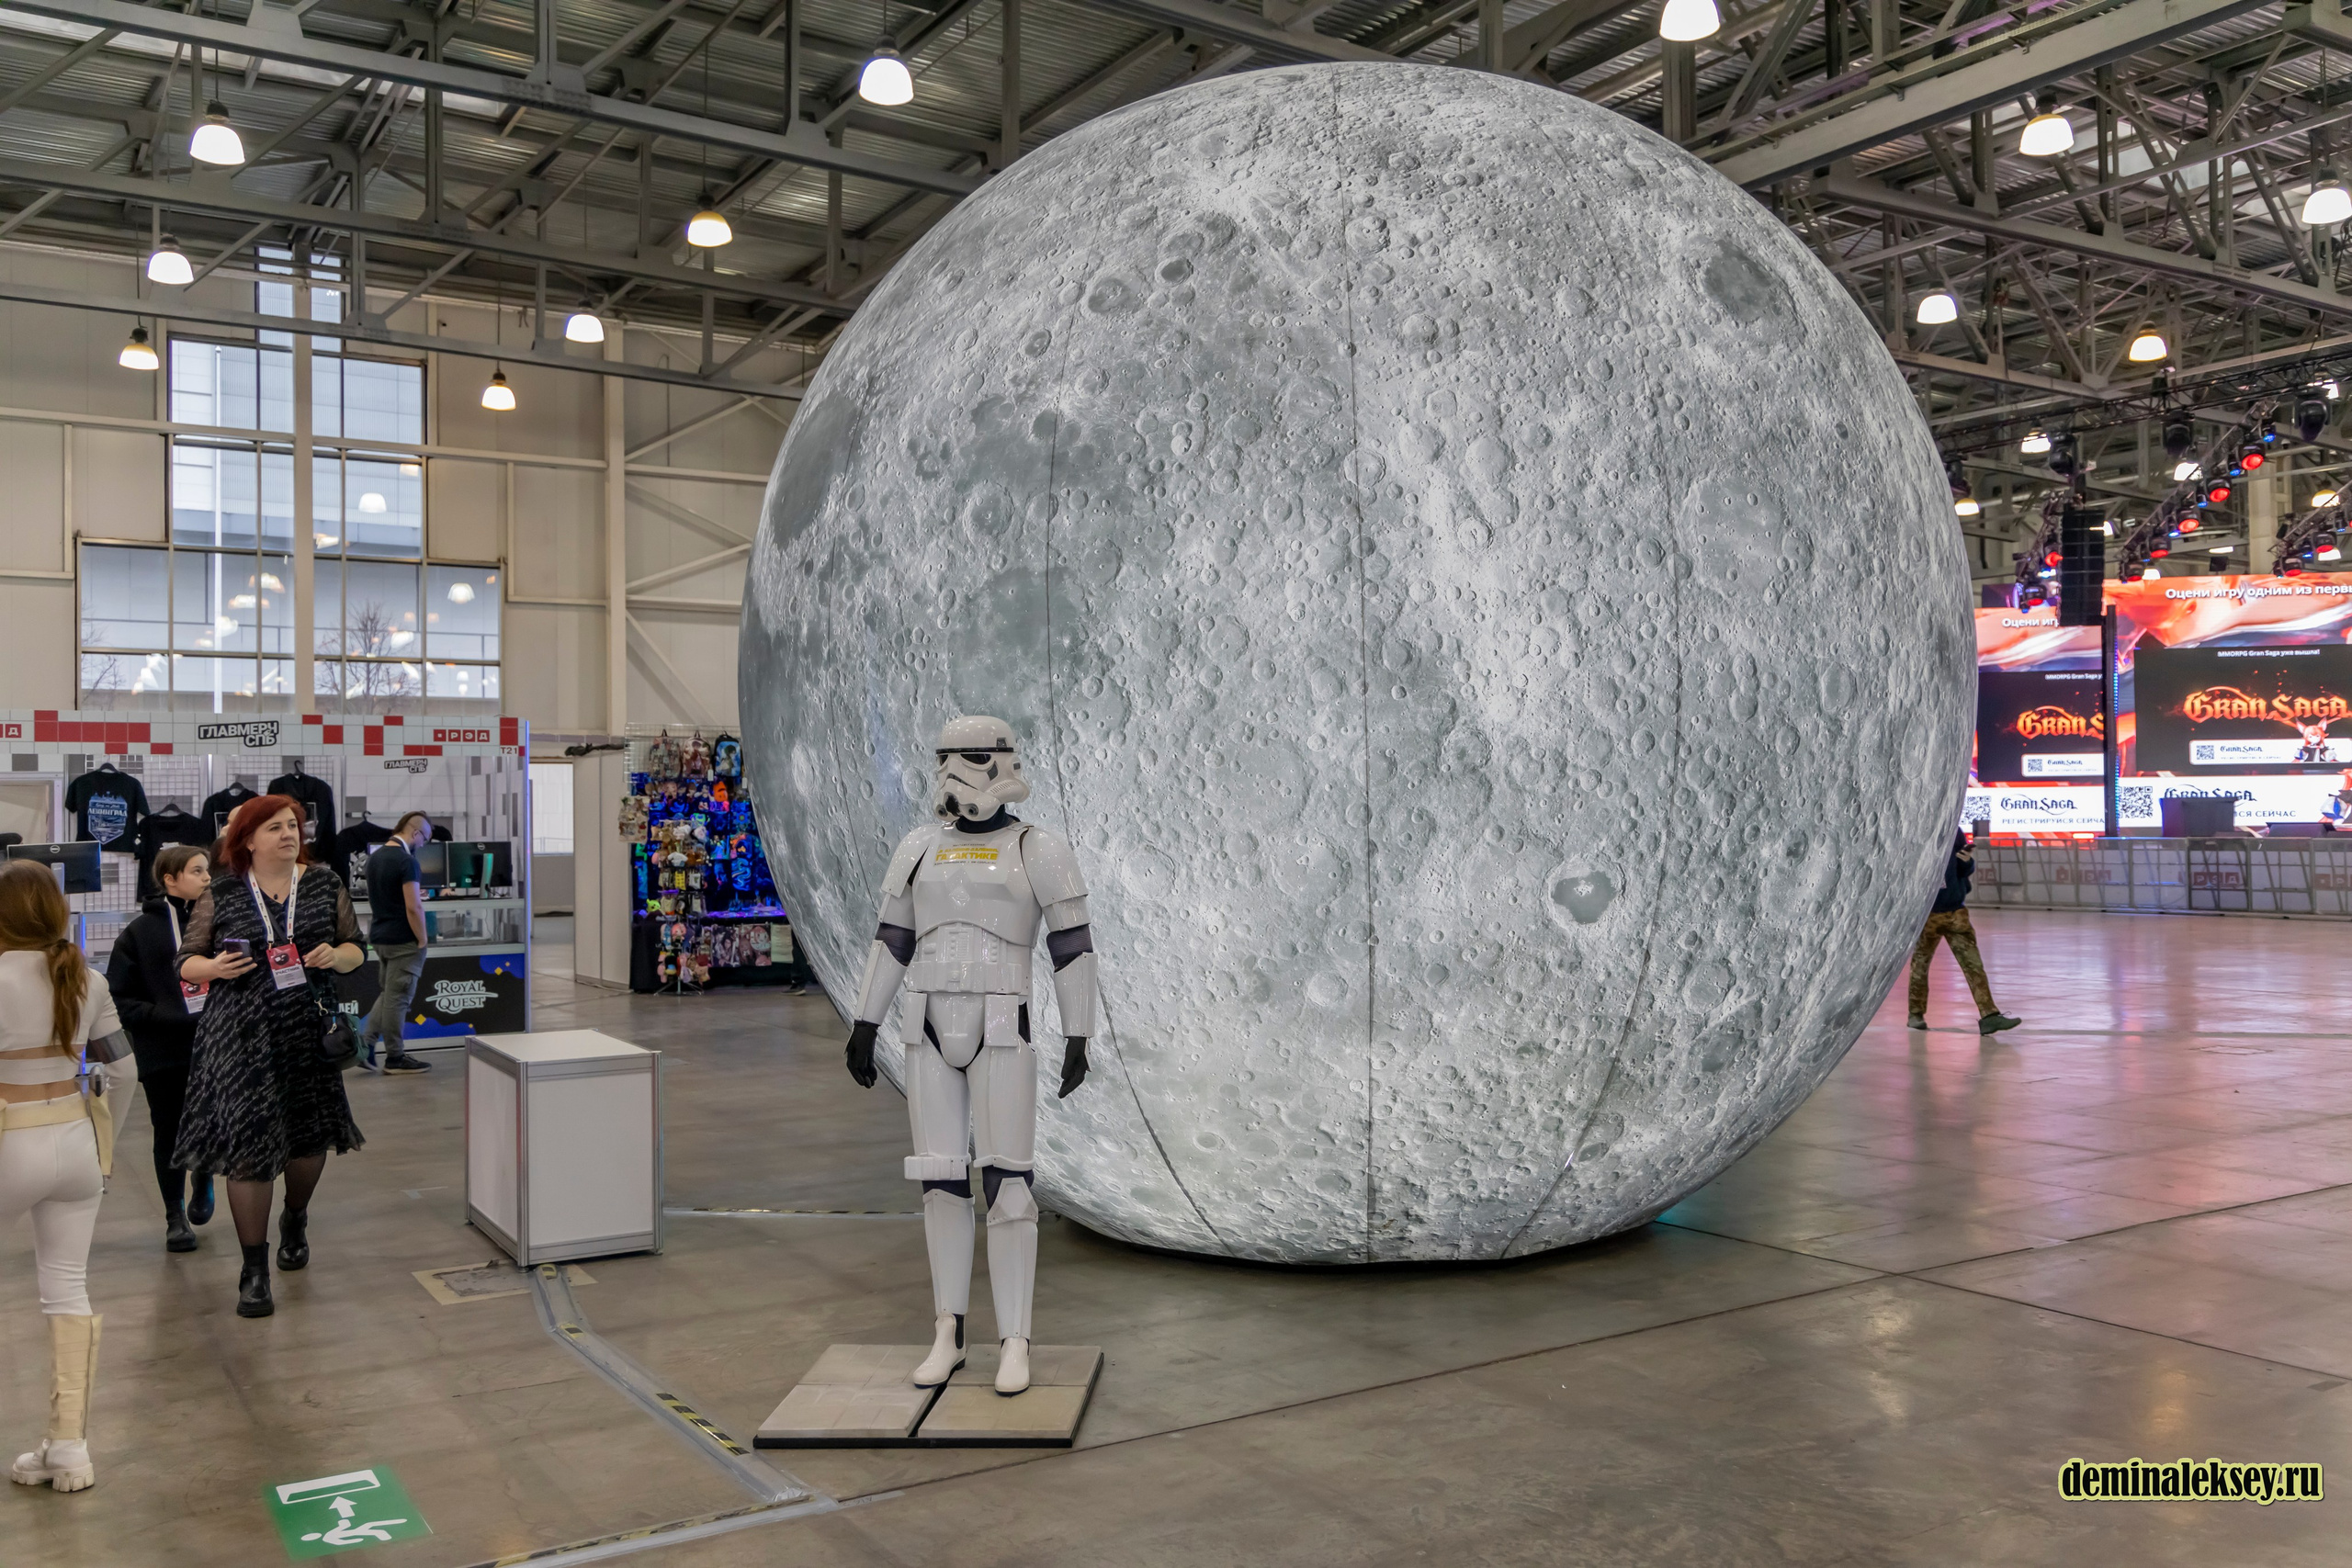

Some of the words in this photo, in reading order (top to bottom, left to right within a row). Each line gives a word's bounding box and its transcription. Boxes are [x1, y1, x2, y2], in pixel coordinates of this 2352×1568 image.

[2165, 588, 2211, 599] Оцени
[2213, 588, 2244, 599] игру
[2246, 585, 2292, 597] одним
[2296, 586, 2312, 595] из
[2002, 618, 2040, 628] Оцени
[198, 721, 278, 739] ГЛАВМЕРЧ
[244, 734, 276, 747] СПБ
[2255, 809, 2297, 818] СЕЙЧАС
